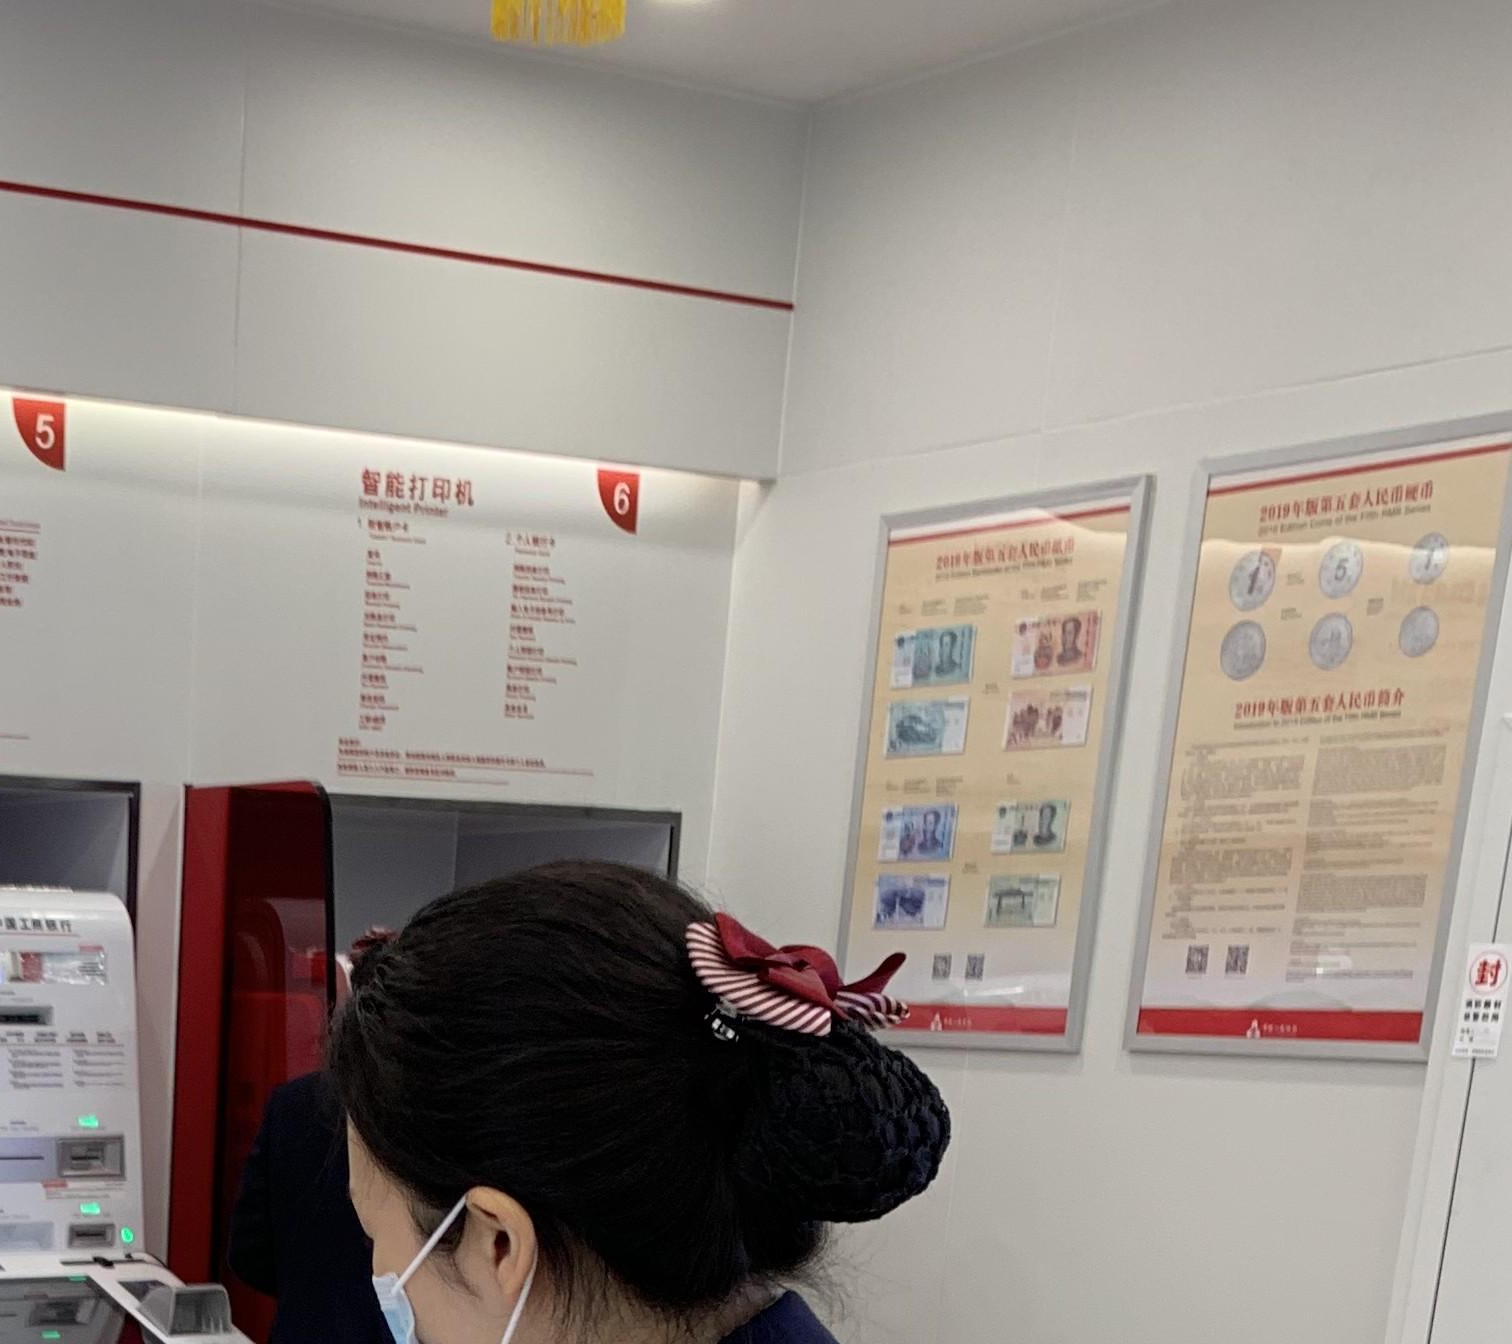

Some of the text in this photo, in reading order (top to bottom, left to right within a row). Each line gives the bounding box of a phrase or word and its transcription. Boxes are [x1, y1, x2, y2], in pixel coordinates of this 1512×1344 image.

[34, 412, 56, 451] 5
[362, 468, 474, 507] 智能打印机
[613, 481, 631, 516] 6
[1475, 958, 1502, 987] 封
